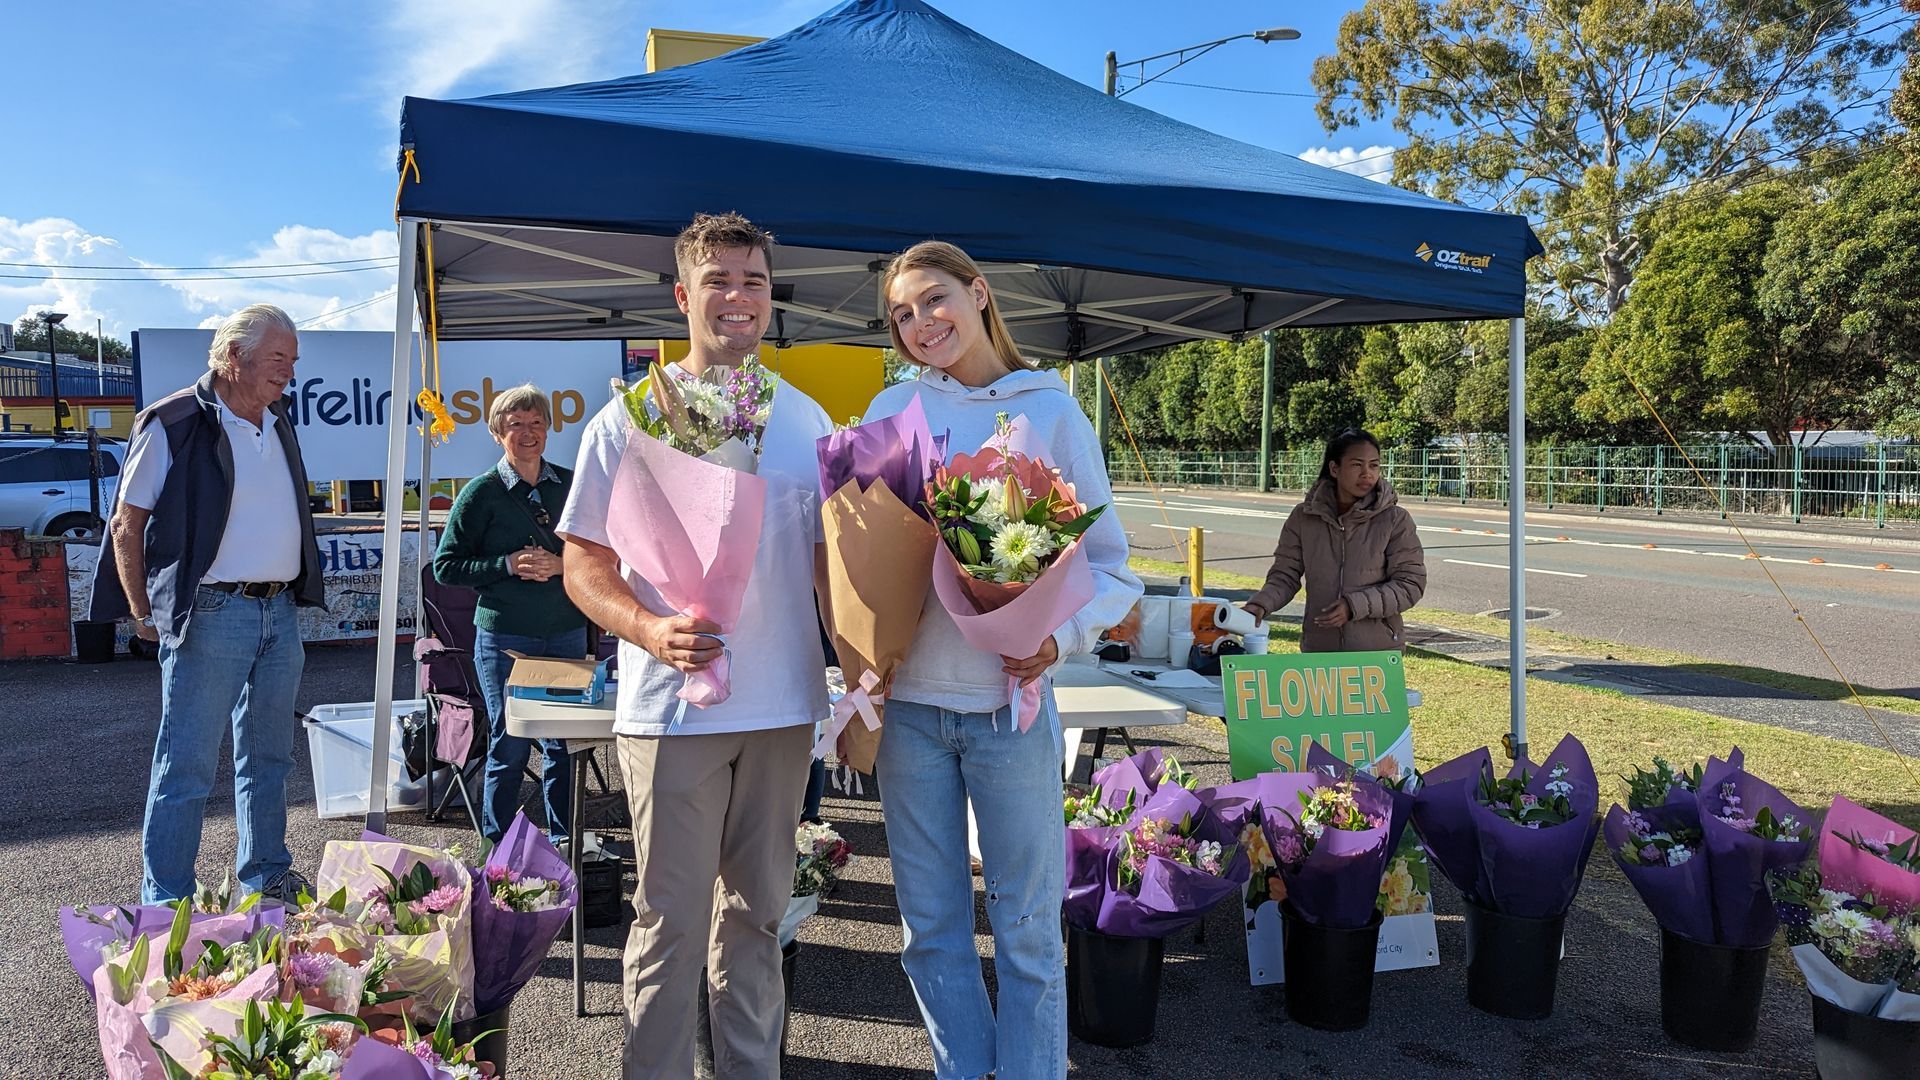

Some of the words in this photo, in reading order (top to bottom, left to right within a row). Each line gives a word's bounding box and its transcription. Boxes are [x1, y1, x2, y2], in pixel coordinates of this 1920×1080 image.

[1436, 249, 1491, 268] OZtrail
[451, 376, 586, 433] shp
[323, 573, 381, 586] STRIBUT
[1234, 665, 1391, 720] FLOWER
